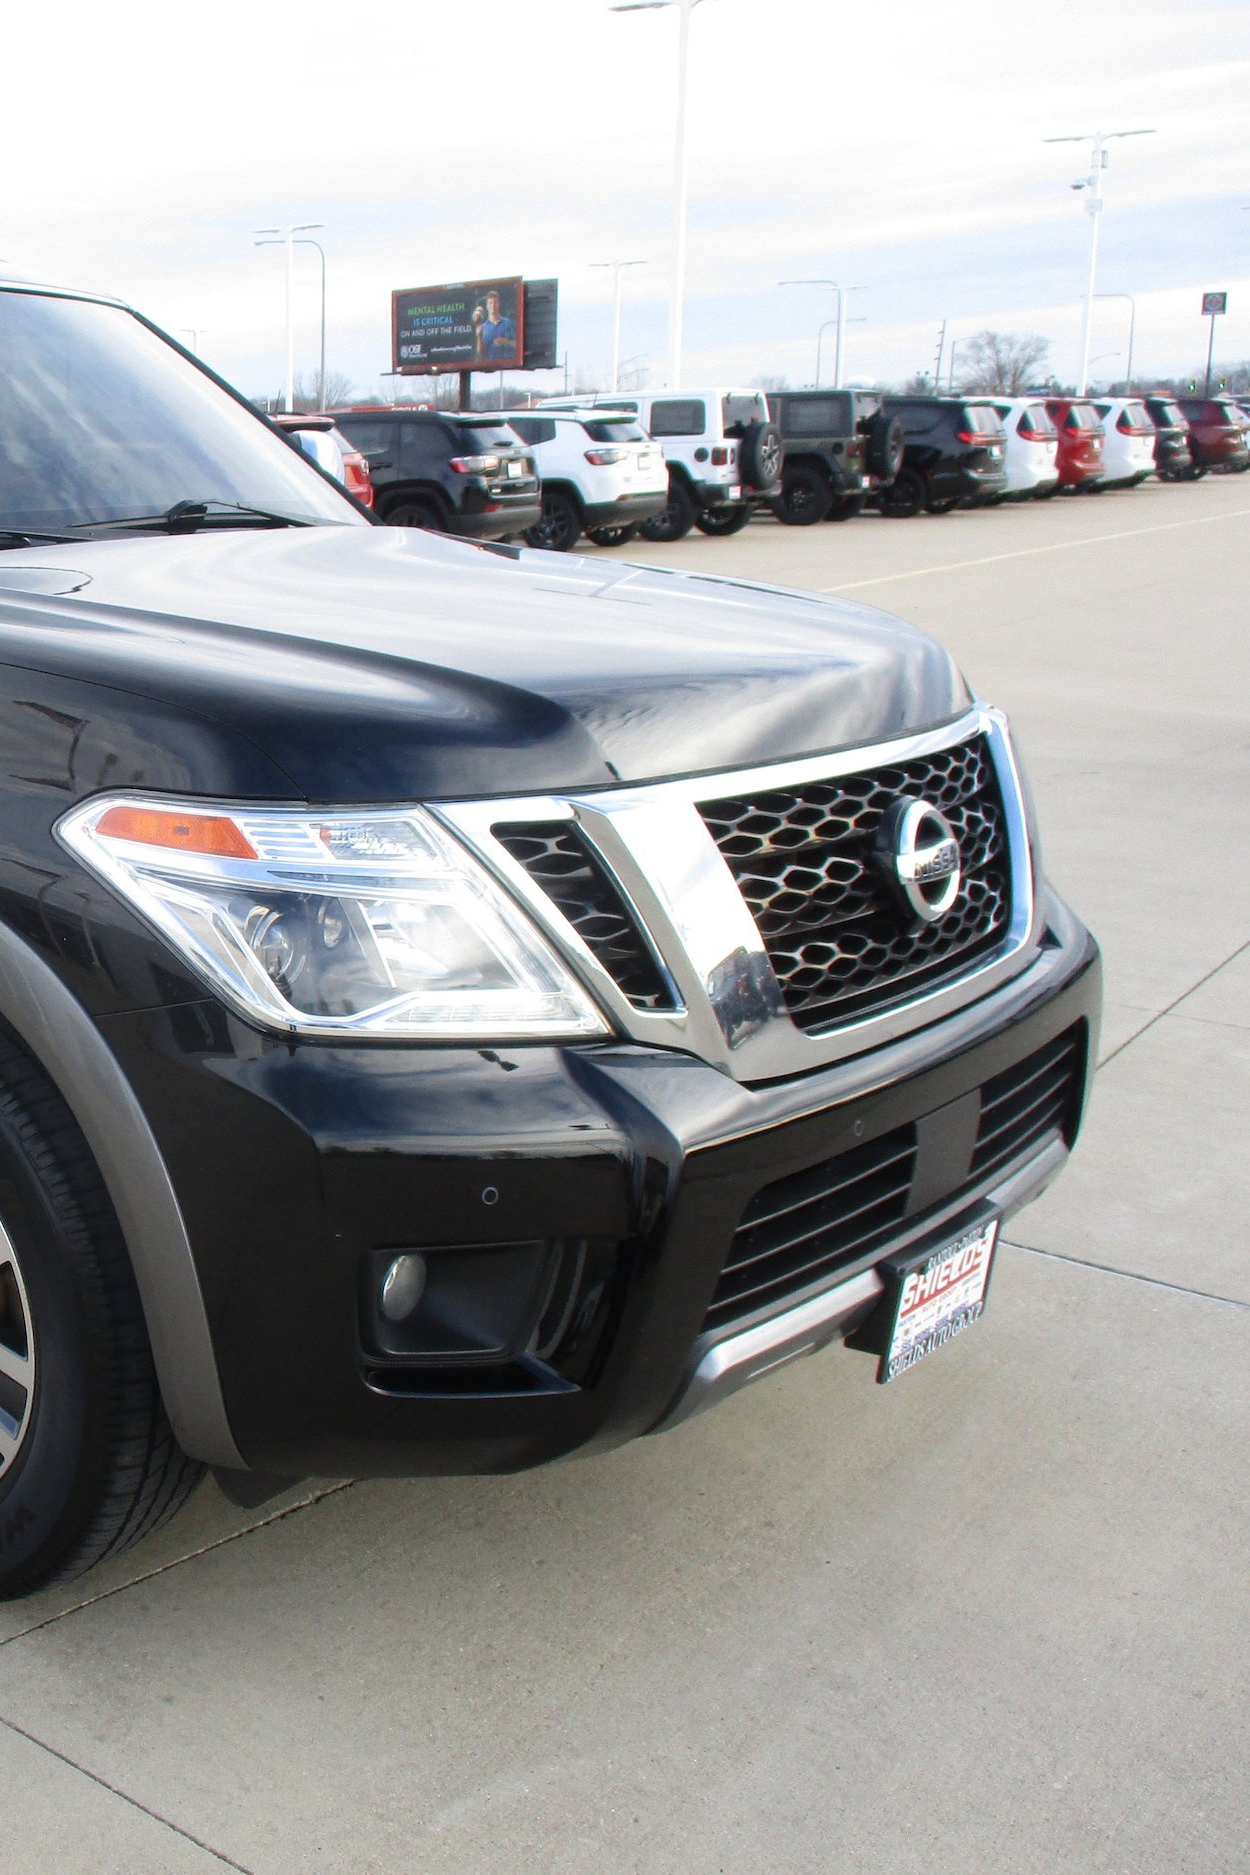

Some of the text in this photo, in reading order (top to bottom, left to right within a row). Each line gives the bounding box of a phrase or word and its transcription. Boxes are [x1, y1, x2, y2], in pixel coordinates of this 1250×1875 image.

[407, 303, 465, 316] MENTAL HEALTH
[413, 315, 453, 327] IS CRITICAL
[400, 330, 410, 338] ON
[411, 329, 425, 337] AND
[426, 327, 439, 336] OFF
[440, 326, 452, 335] THE
[408, 344, 421, 354] OSF
[903, 1239, 988, 1311] SHIELDS
[886, 1339, 926, 1382] SHIELDS
[925, 1323, 952, 1356] AUTO
